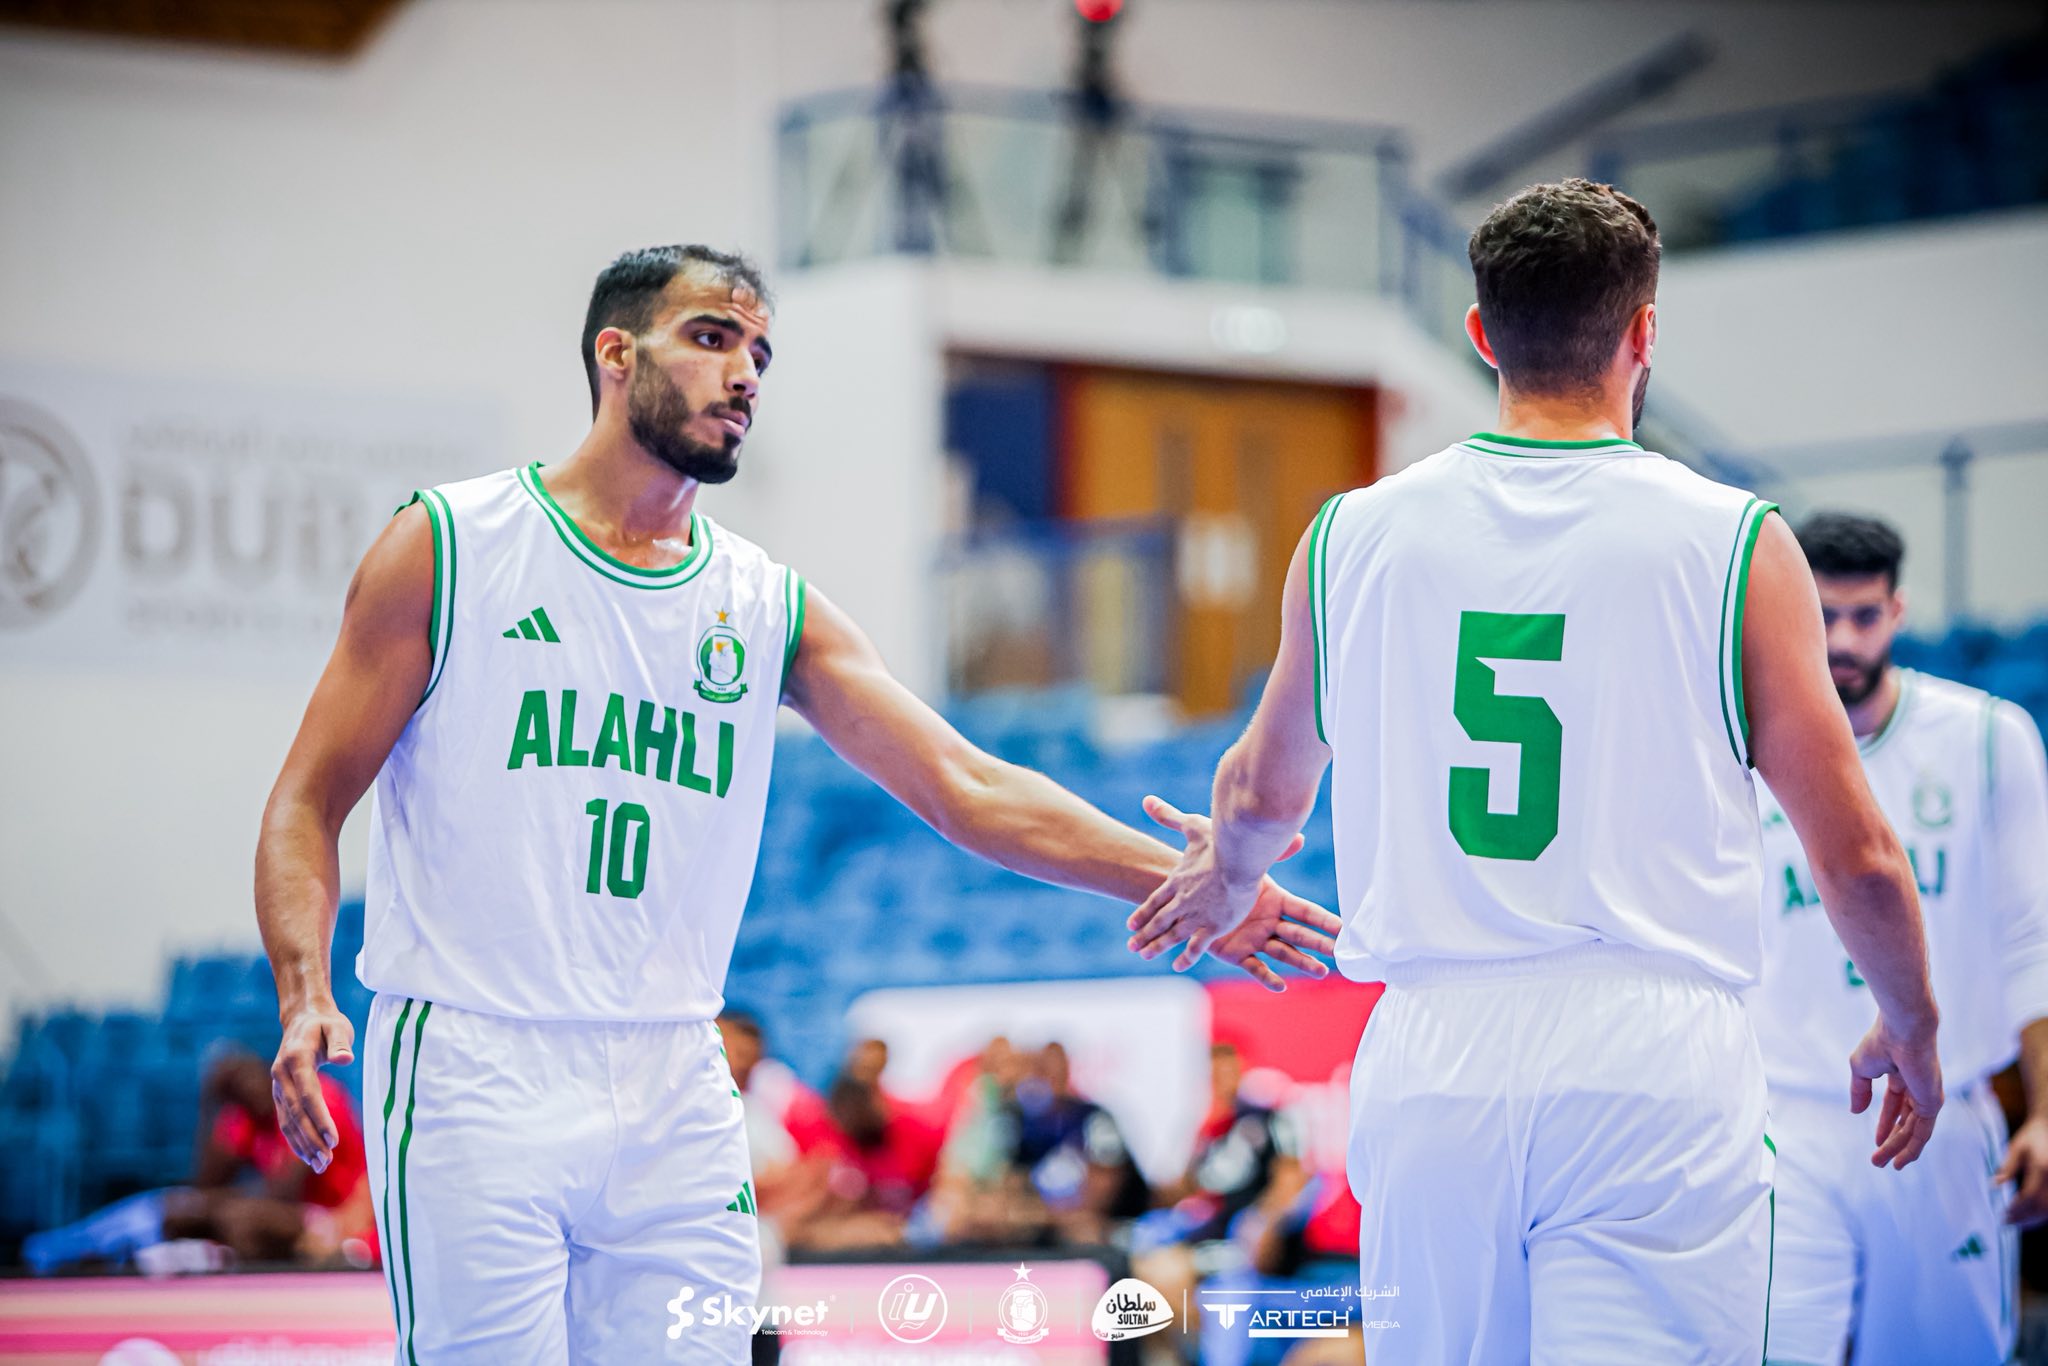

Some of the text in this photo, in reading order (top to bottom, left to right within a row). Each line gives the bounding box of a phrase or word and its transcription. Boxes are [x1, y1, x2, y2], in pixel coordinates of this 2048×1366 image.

[507, 690, 735, 799] ALAHLI
[1448, 610, 1566, 862] 5
[585, 798, 650, 899] 10
